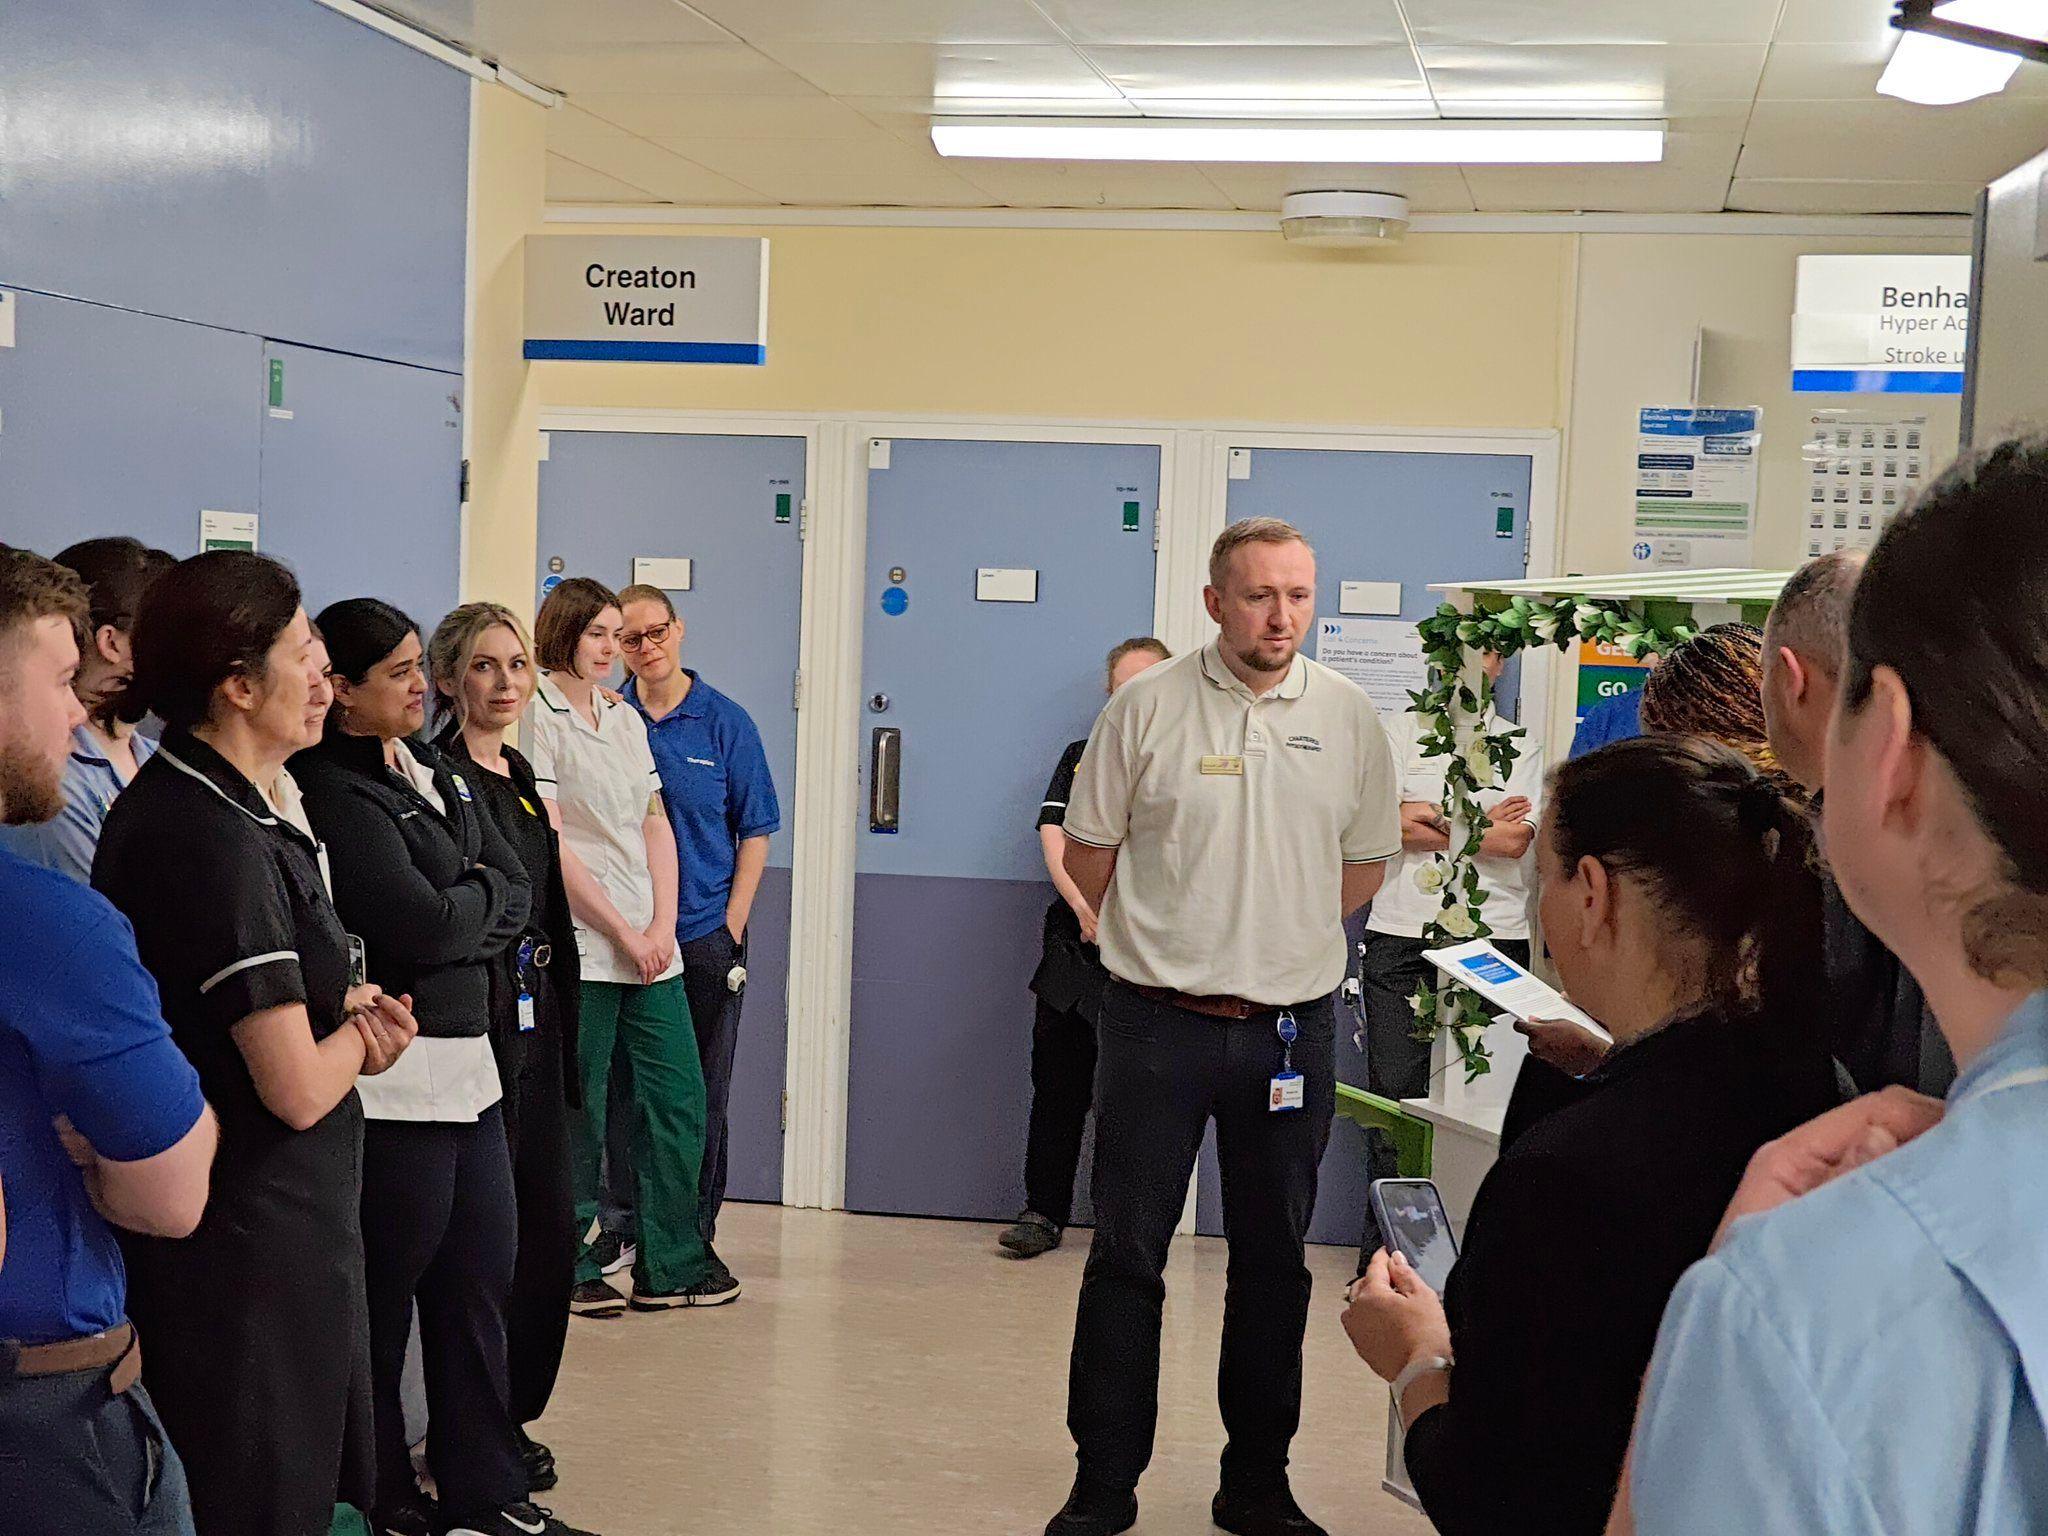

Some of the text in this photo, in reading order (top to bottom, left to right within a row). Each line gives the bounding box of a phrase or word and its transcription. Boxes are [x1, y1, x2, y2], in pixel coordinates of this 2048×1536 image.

[586, 263, 696, 289] Creaton
[1882, 285, 1968, 308] Benha
[604, 301, 675, 326] Ward
[1880, 315, 1938, 335] Hyper
[1884, 346, 1947, 364] Stroke
[1346, 648, 1362, 656] have
[1359, 657, 1394, 665] condition?
[1597, 681, 1628, 697] GO
